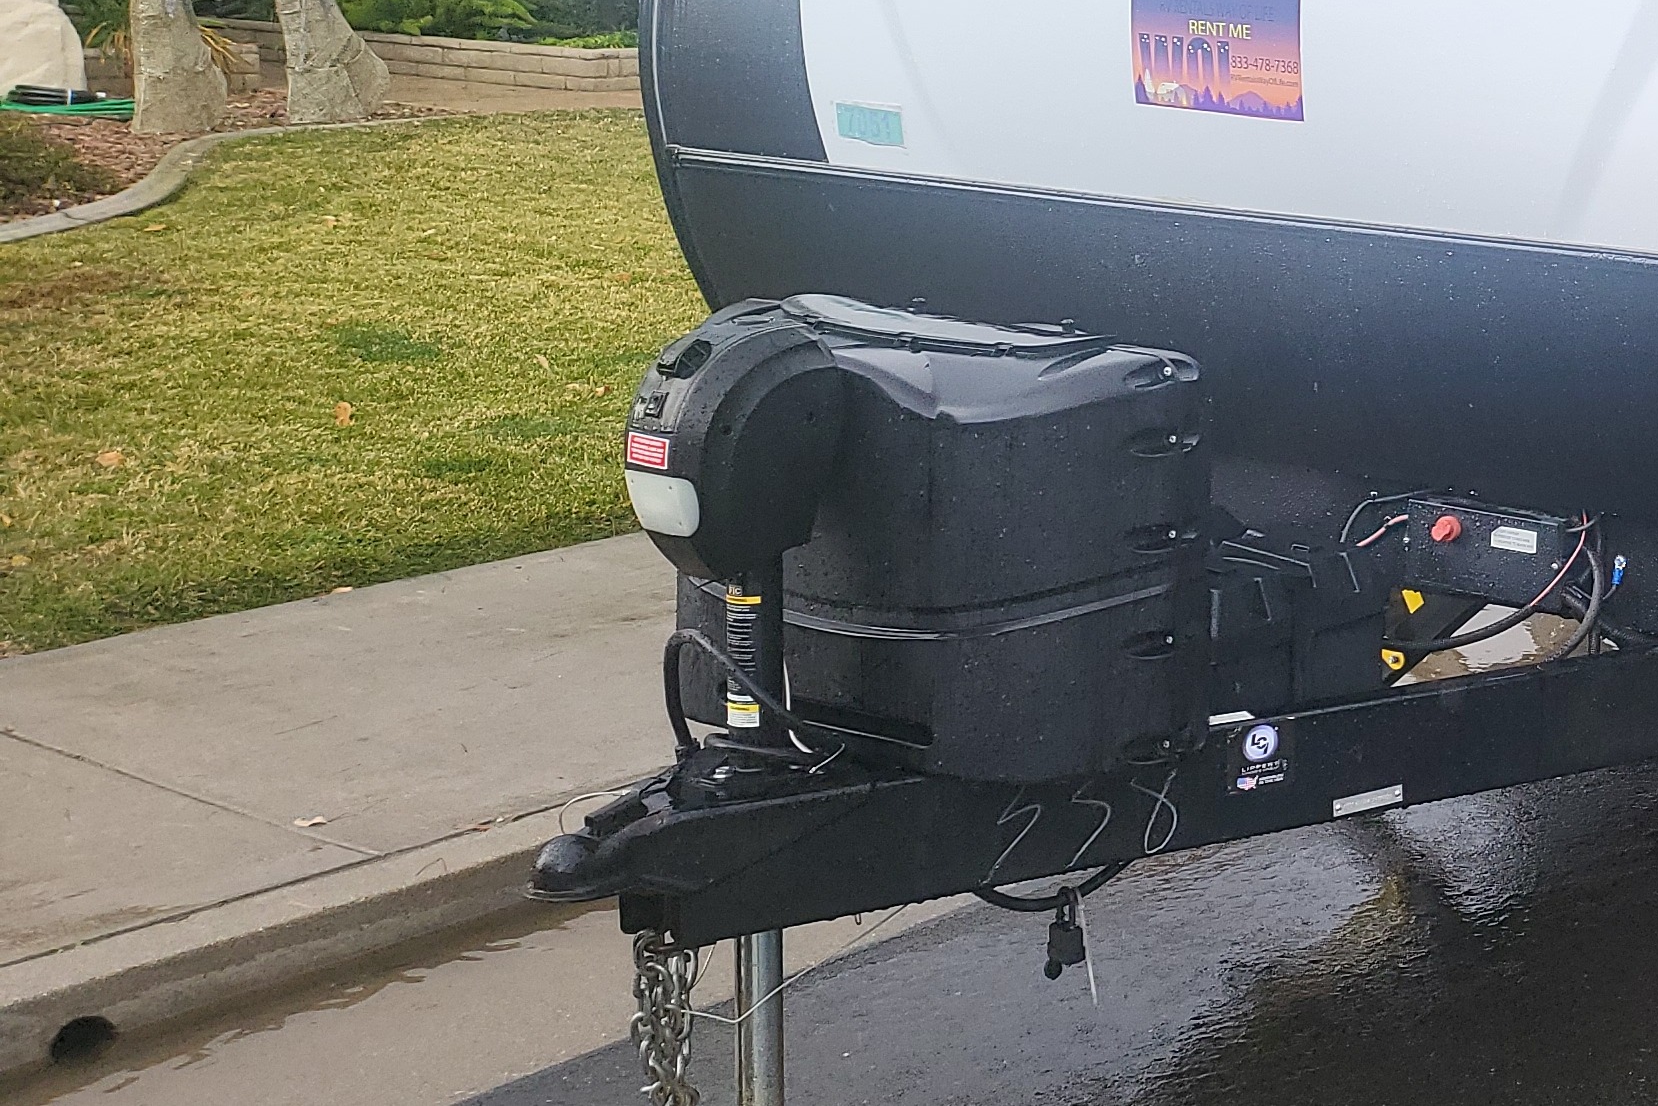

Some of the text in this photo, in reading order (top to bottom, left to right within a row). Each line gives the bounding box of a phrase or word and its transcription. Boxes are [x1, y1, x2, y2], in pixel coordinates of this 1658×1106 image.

[1188, 19, 1252, 40] RENT ME
[1230, 55, 1299, 75] 833-478-7368
